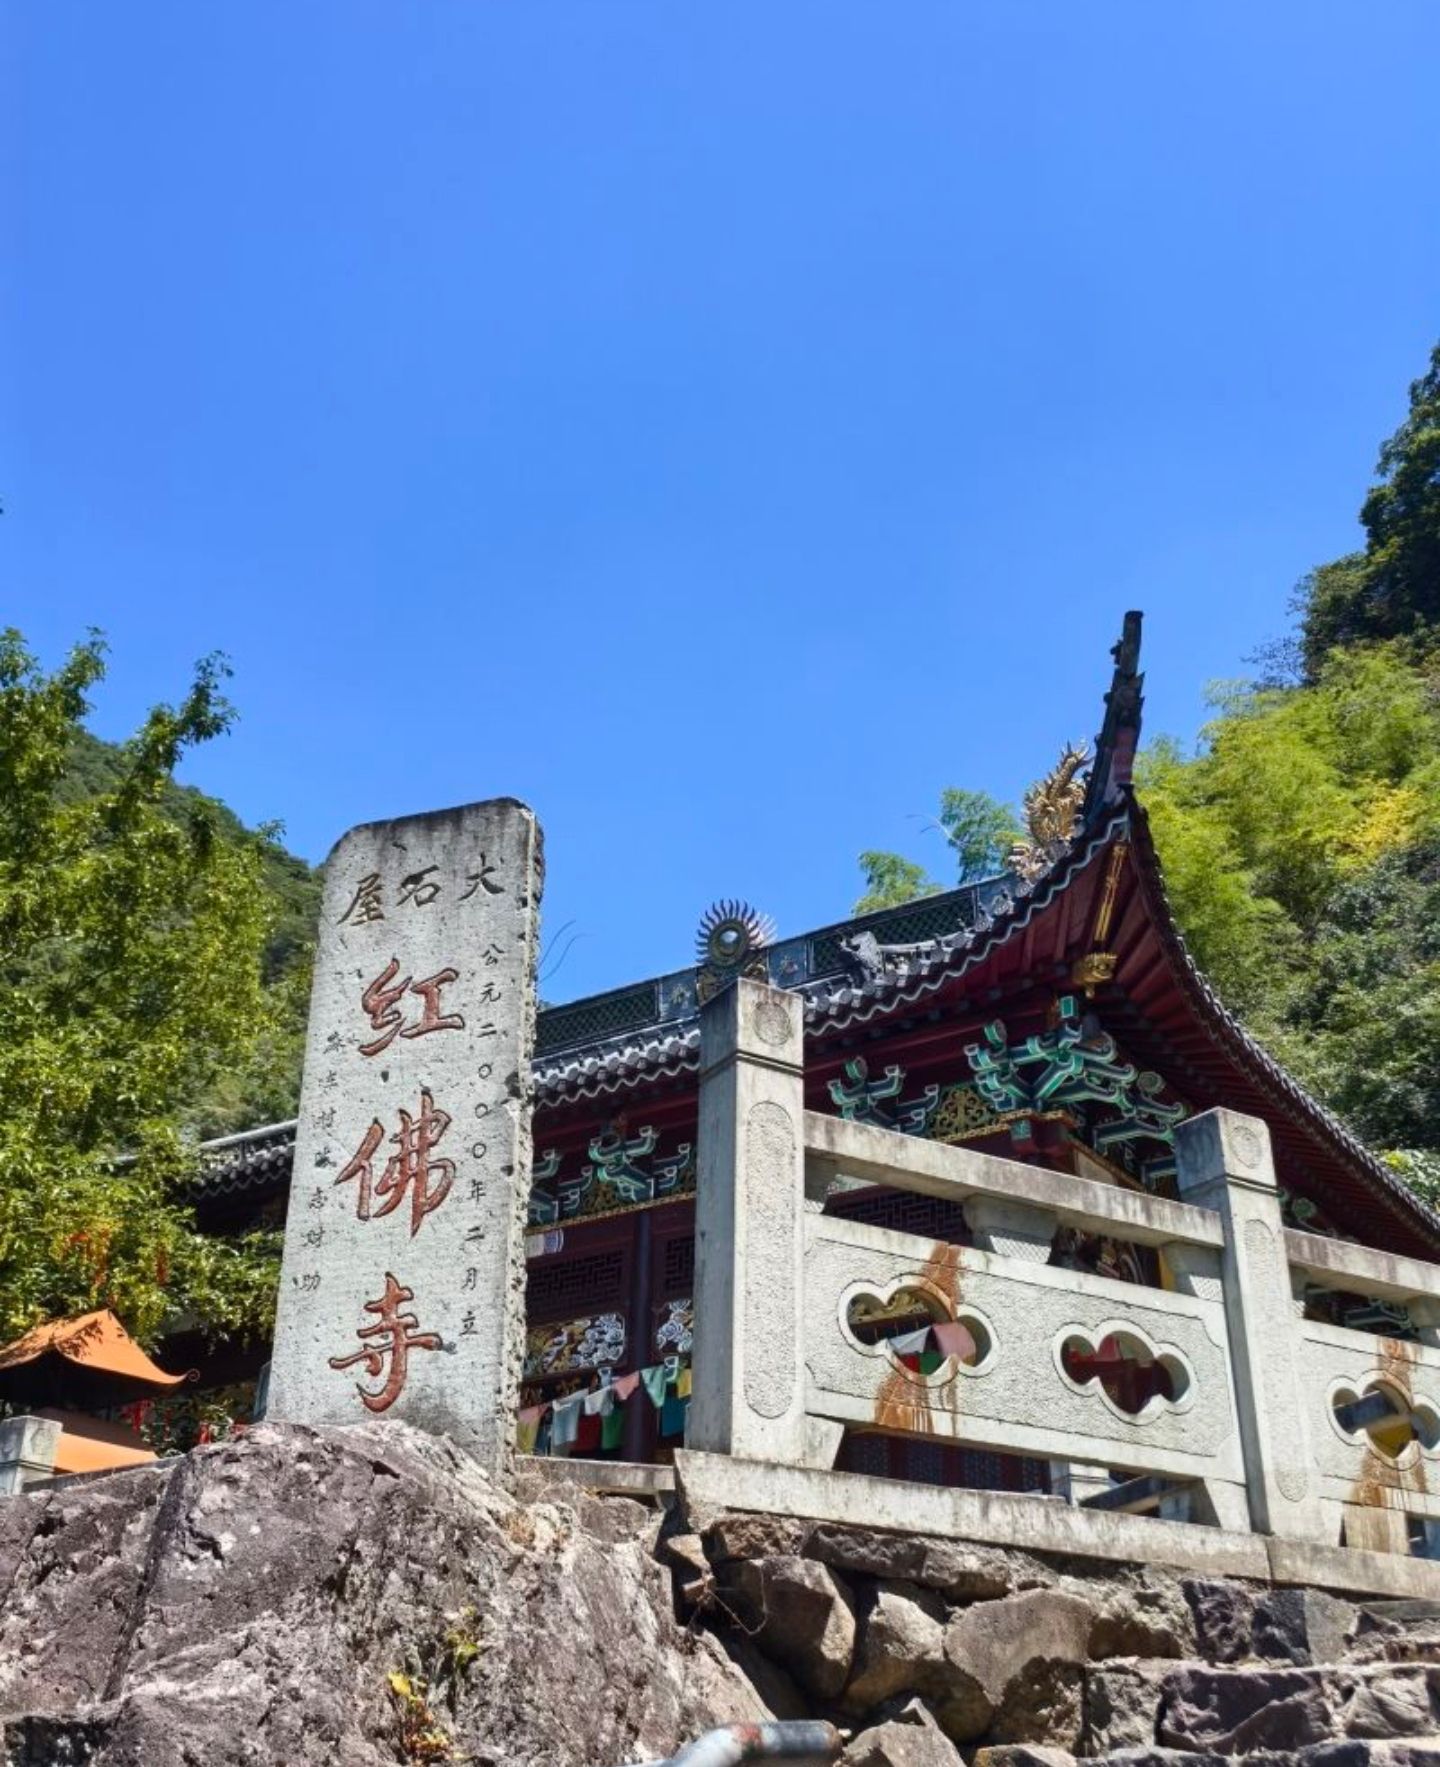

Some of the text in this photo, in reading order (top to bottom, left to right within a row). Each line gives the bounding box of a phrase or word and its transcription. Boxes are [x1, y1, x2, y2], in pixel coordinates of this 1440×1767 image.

[336, 851, 505, 926] 大石屋
[328, 955, 465, 1413] 红佛寺
